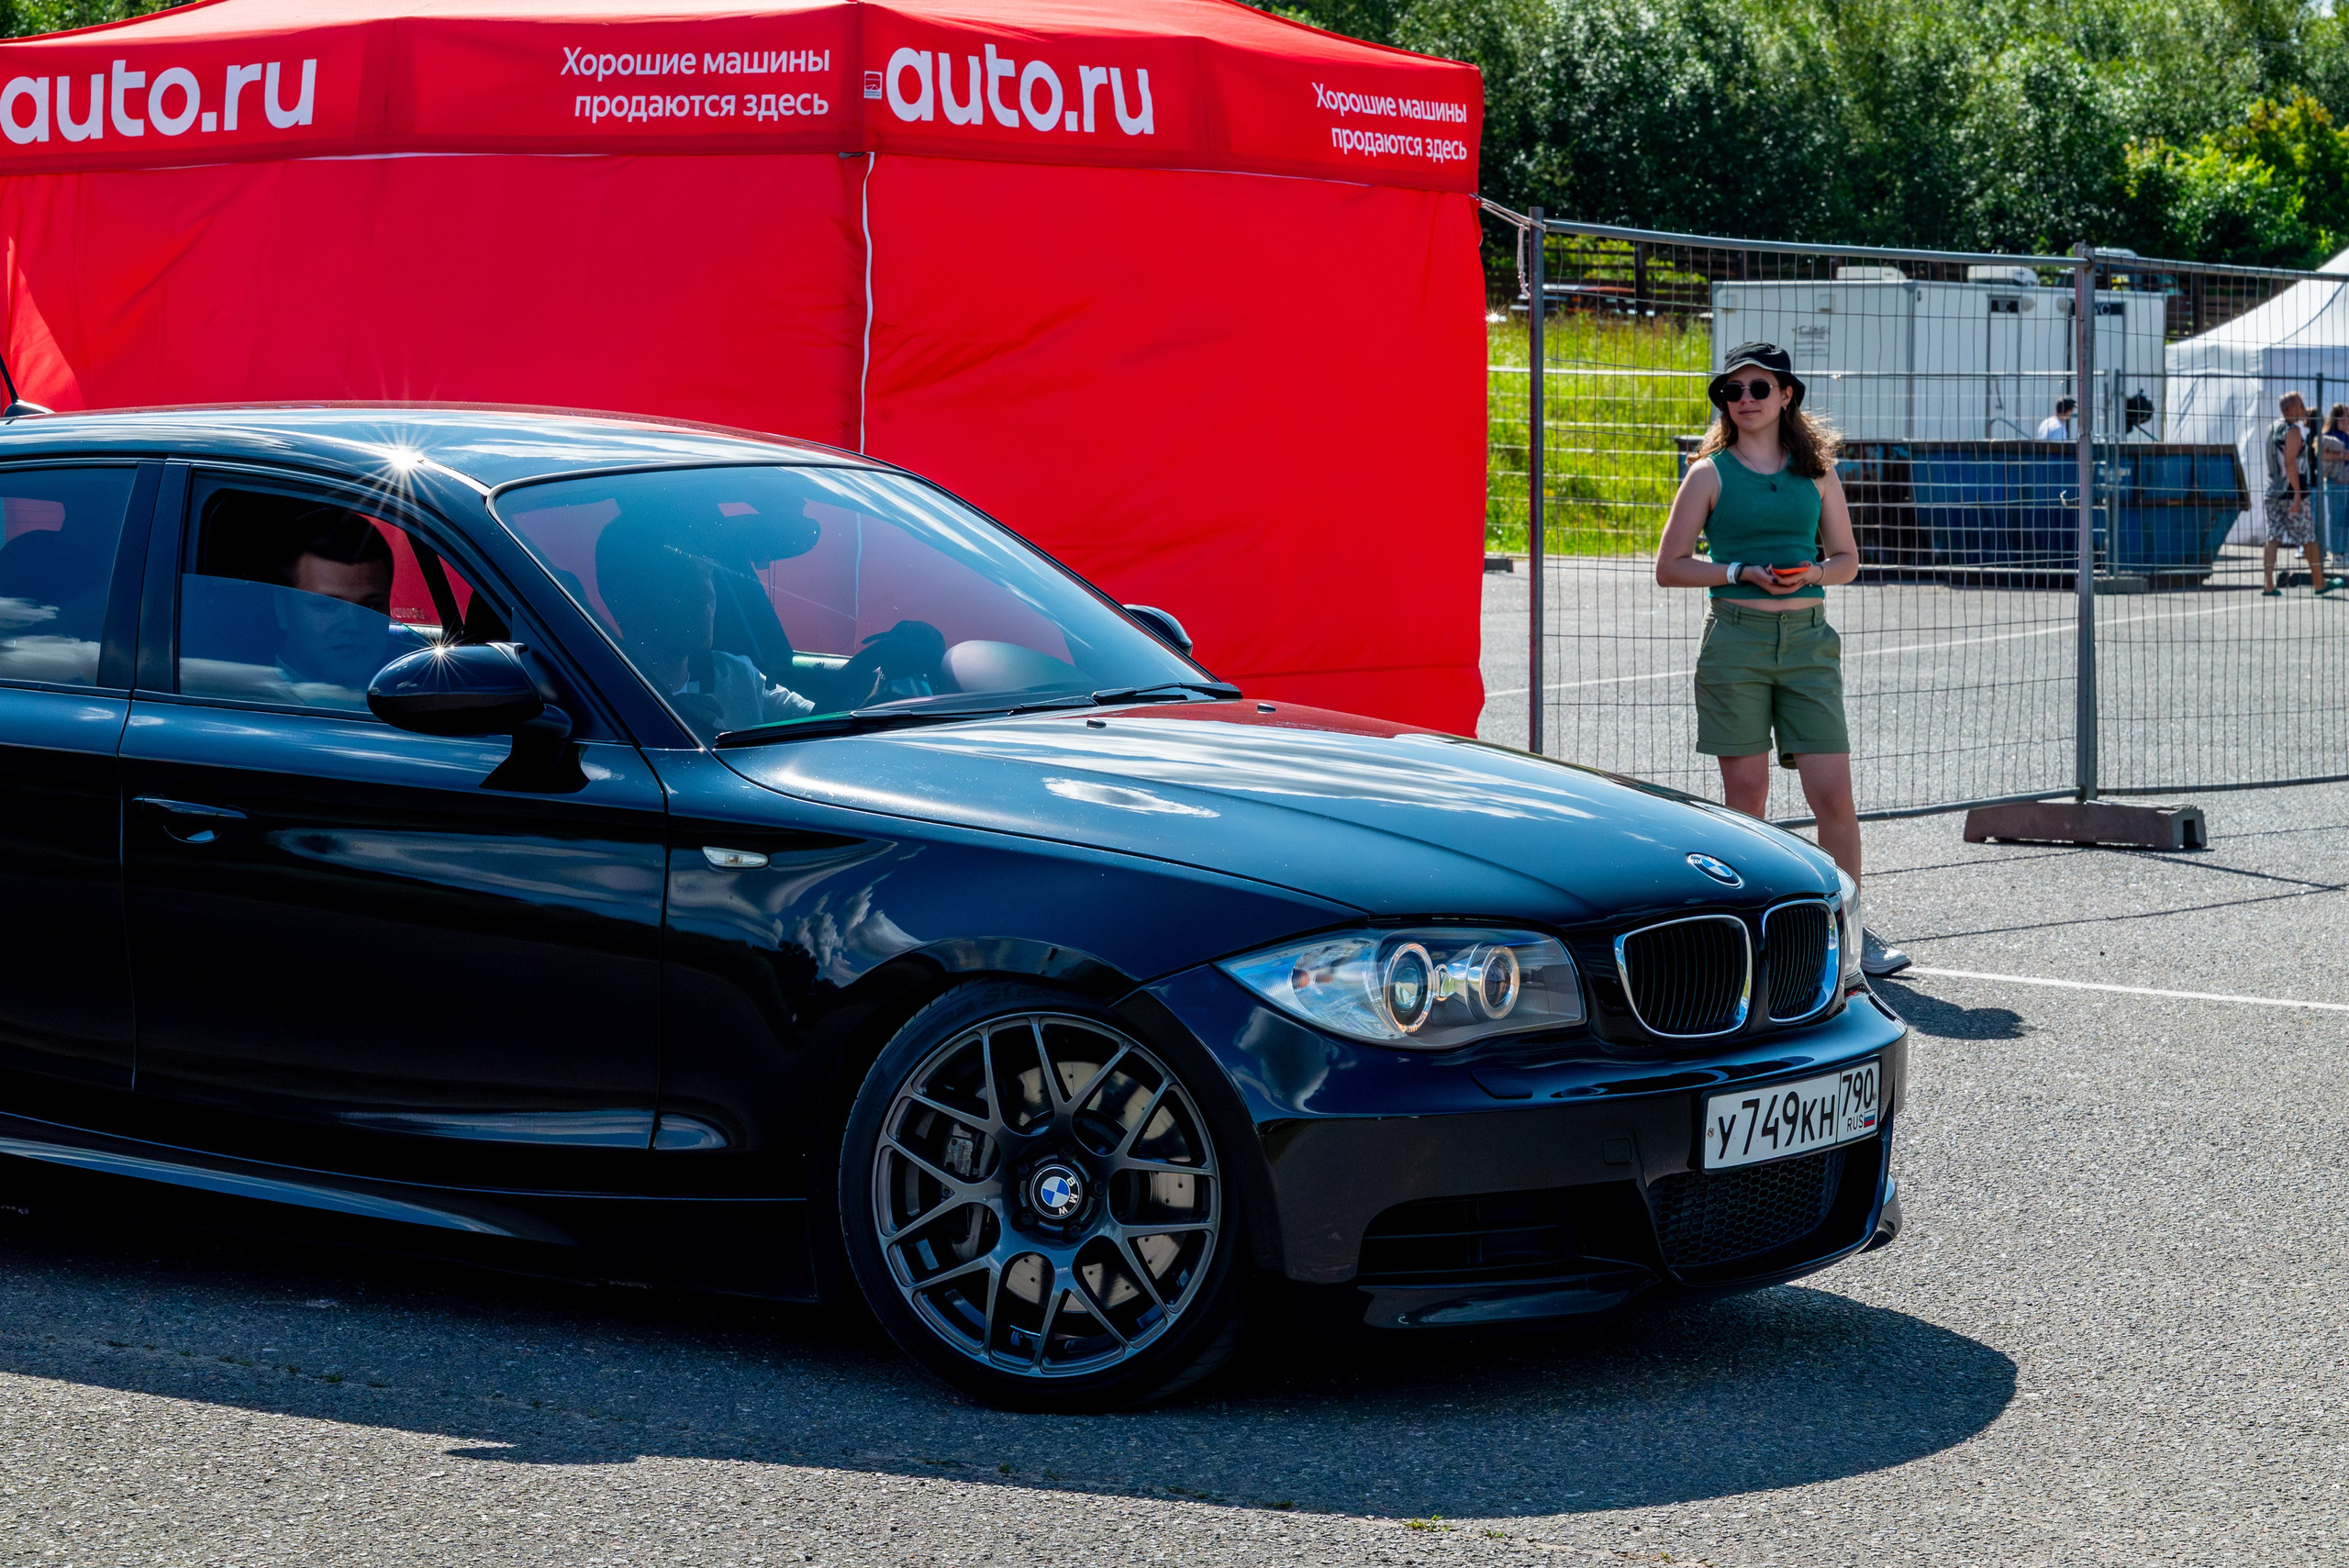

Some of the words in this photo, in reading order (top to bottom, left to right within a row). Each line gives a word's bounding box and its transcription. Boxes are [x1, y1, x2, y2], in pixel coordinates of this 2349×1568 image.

[560, 47, 696, 82] Хорошие
[703, 50, 829, 74] машины
[0, 59, 317, 145] auto.ru
[574, 95, 736, 124] продаются
[742, 93, 829, 121] здесь
[885, 43, 1154, 136] auto.ru
[1311, 82, 1397, 117] Хорошие
[1398, 98, 1467, 123] машины
[1331, 127, 1423, 157] продаются
[1425, 138, 1467, 163] здесь
[1842, 1067, 1874, 1117] 790
[1847, 1114, 1864, 1132] RUS
[1058, 1176, 1078, 1216] BMW
